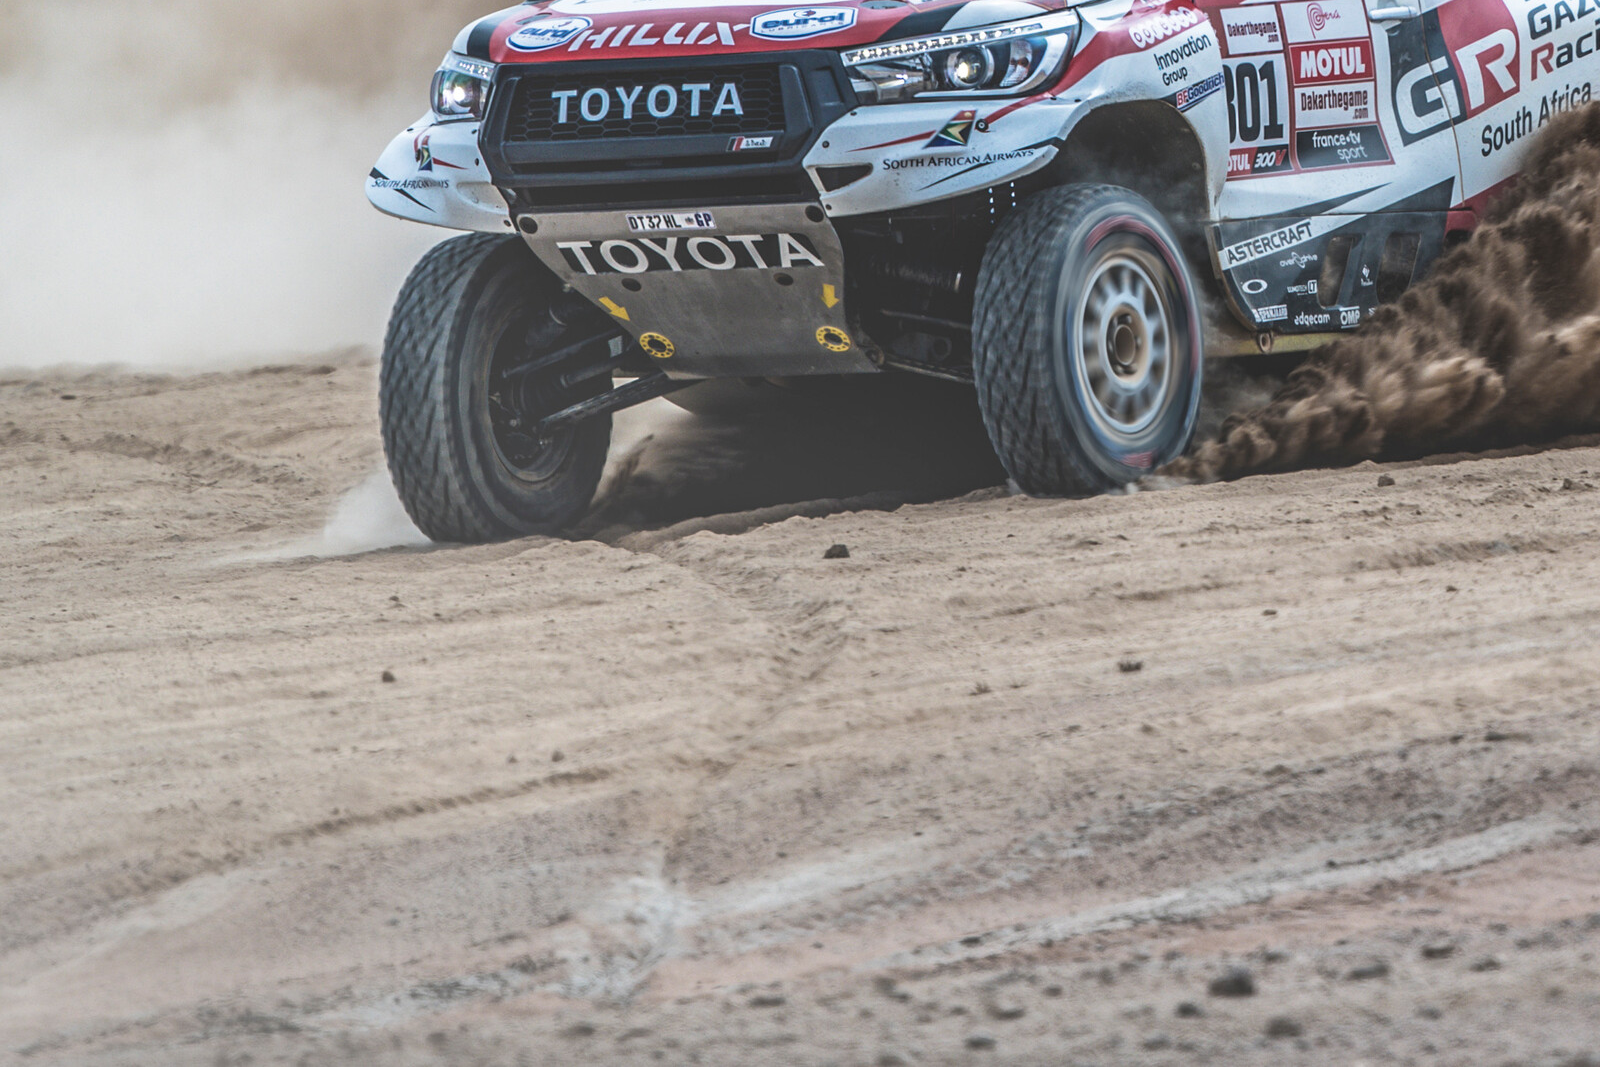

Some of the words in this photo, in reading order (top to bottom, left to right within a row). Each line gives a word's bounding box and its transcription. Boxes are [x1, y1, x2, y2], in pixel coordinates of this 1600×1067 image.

[761, 12, 845, 29] eurol
[1227, 21, 1277, 37] Dakarthegame
[1154, 34, 1212, 70] Innovation
[1300, 47, 1366, 79] MOTUL
[1162, 66, 1188, 86] Group
[551, 82, 744, 124] TOYOTA
[1300, 89, 1368, 112] Dakarthegame
[1352, 108, 1369, 120] .com
[1481, 105, 1533, 157] South
[1538, 82, 1592, 128] Africa
[883, 158, 924, 170] SOUTH
[927, 155, 981, 168] AFRICAN
[982, 149, 1034, 163] AIRWAYS
[1227, 153, 1250, 173] OTUL
[1254, 149, 1287, 168] 300V
[1337, 146, 1368, 163] sport
[694, 213, 713, 228] GP
[556, 233, 826, 275] TOYOTA
[1340, 310, 1361, 325] OMP
